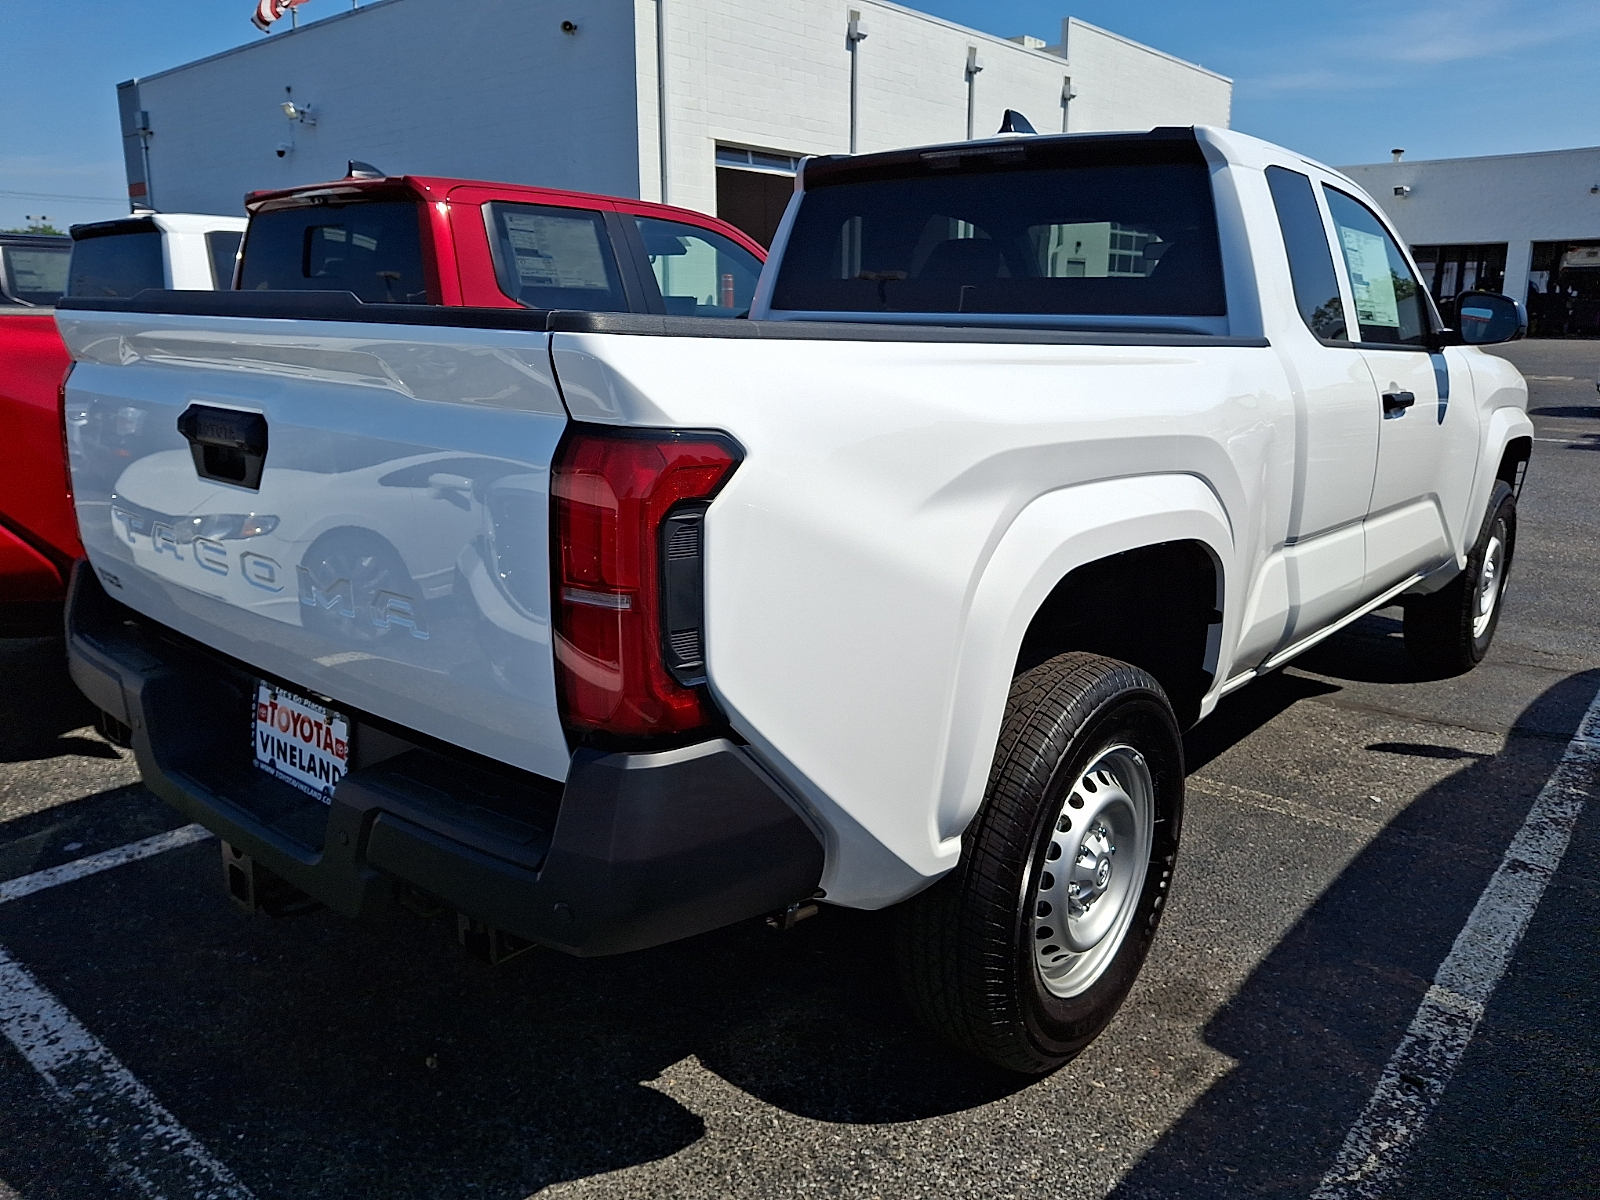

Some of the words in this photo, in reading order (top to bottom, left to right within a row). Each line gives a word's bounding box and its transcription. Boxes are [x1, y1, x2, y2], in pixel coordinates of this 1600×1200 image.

[111, 504, 430, 640] TACOMA
[268, 699, 336, 757] TOYOTA
[260, 730, 342, 787] VINELAND
